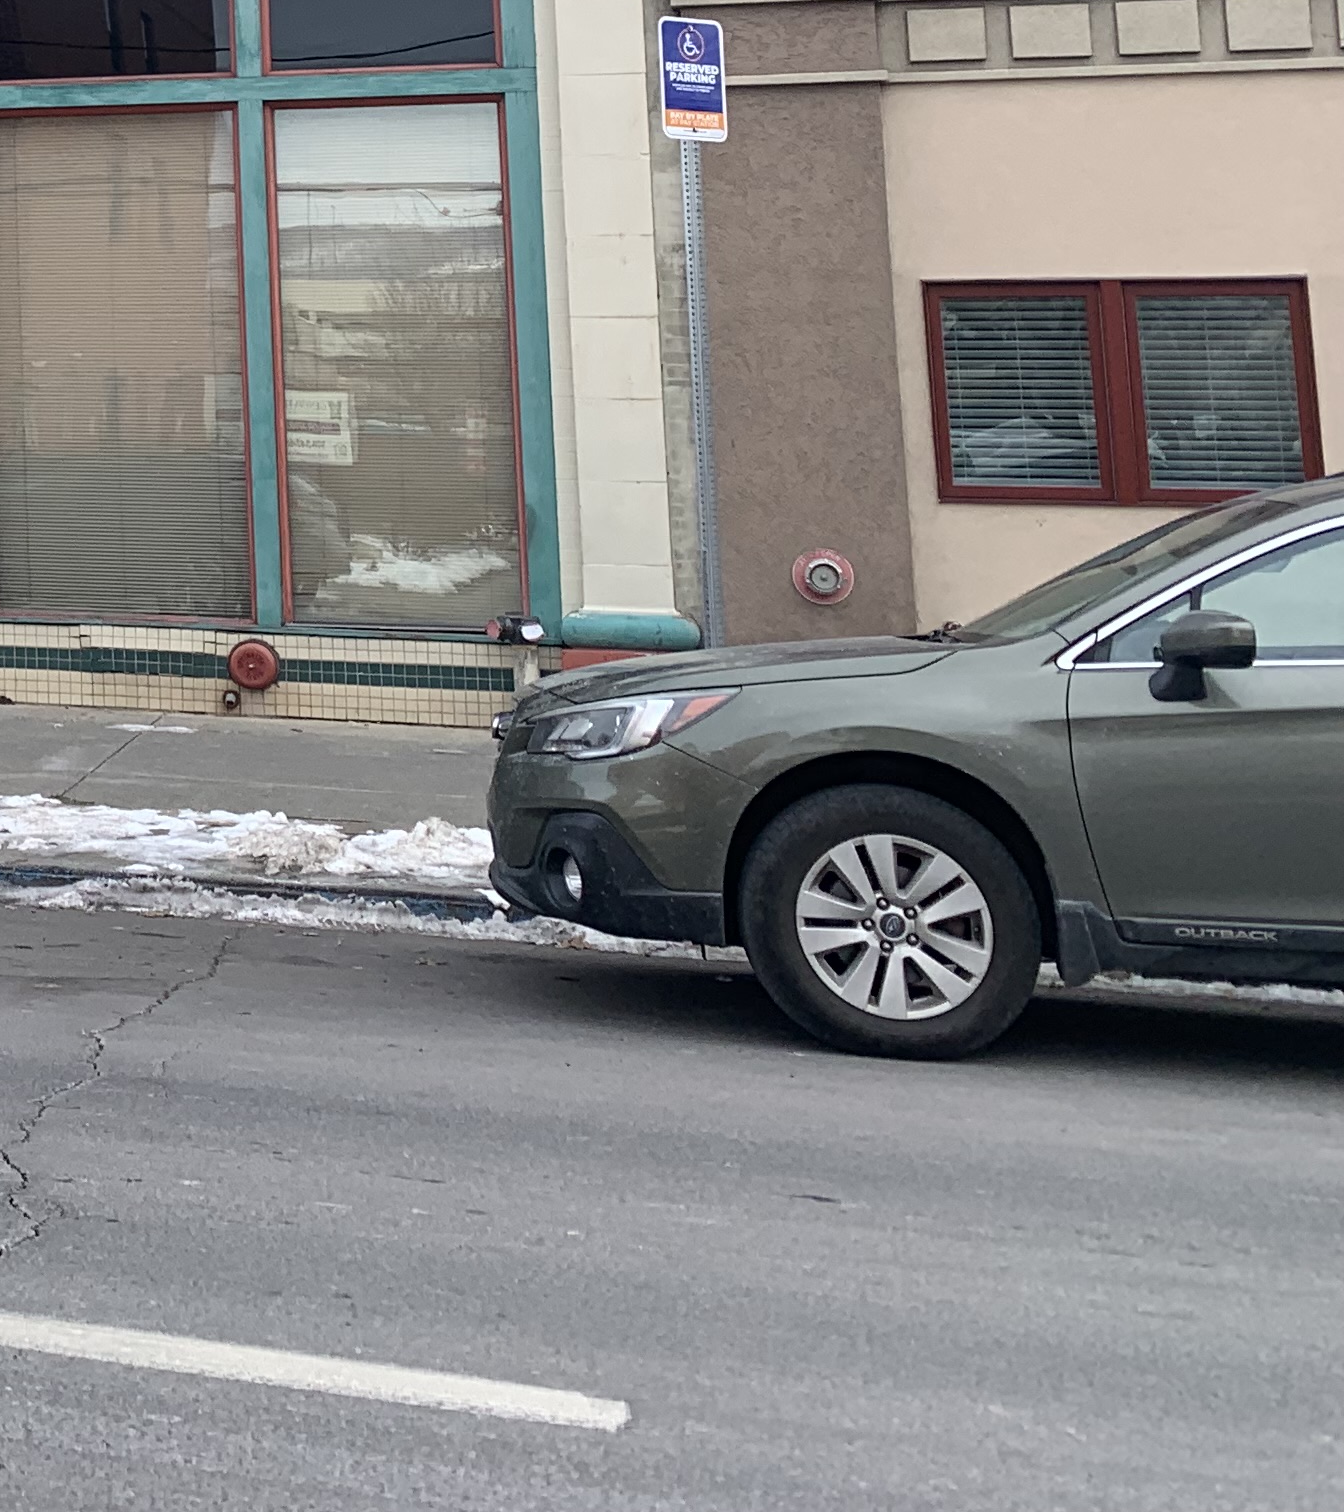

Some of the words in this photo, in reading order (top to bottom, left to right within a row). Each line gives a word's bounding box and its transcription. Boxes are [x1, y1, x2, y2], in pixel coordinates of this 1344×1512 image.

[665, 61, 720, 76] RESERVED
[669, 72, 716, 85] PARKING
[1174, 927, 1278, 942] OUTBACK
